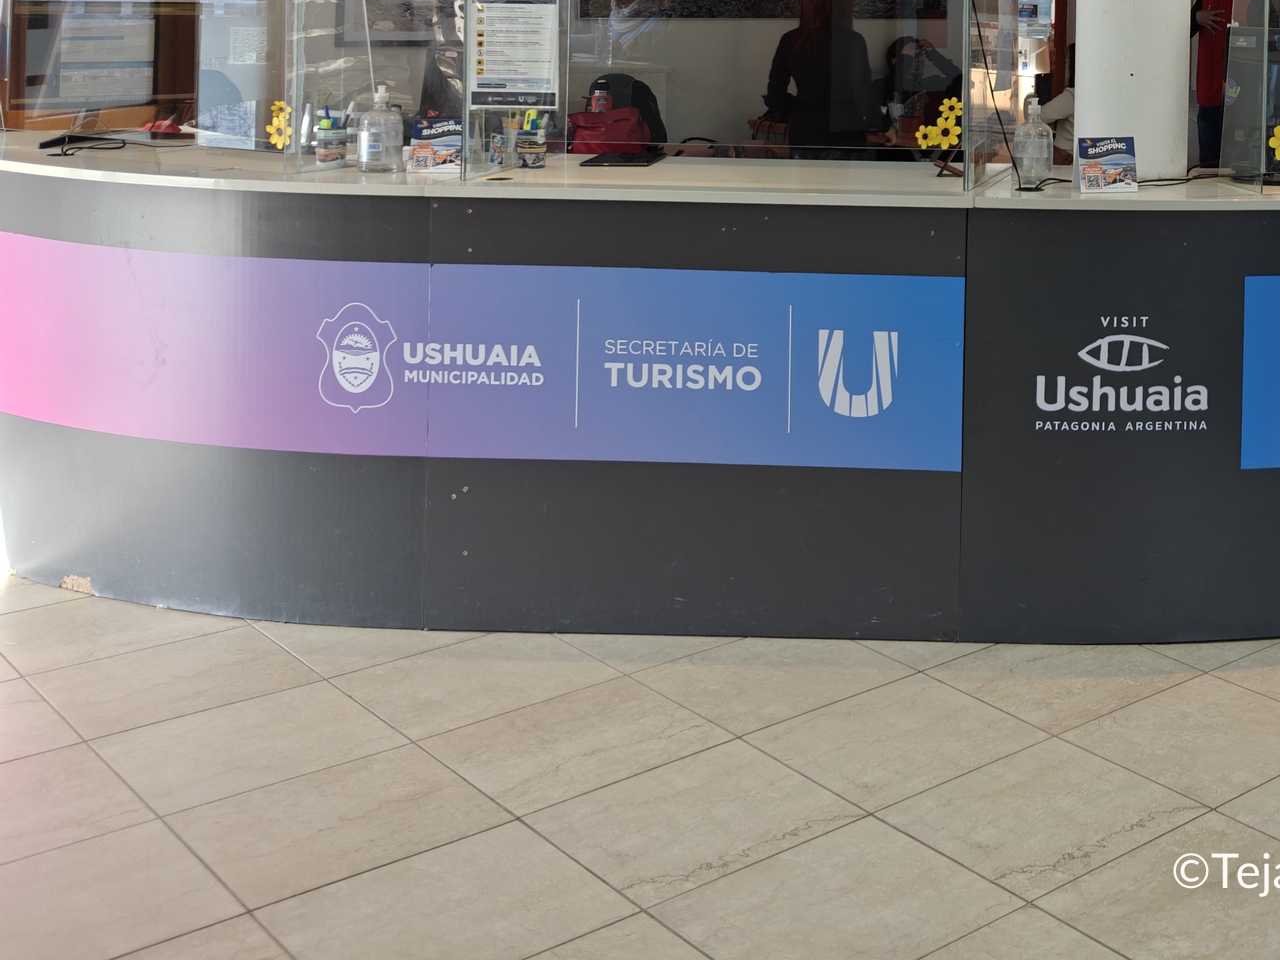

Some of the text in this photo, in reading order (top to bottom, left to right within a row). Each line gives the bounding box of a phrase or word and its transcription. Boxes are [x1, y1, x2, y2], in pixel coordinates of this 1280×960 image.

[1088, 142, 1126, 154] SHOPPING
[1100, 316, 1149, 328] VISIT
[402, 342, 542, 368] USHUAIA
[604, 337, 758, 358] SECRETARÍA DE
[404, 369, 544, 387] MUNICIPALIDAD
[604, 362, 762, 392] TURISMO
[1036, 375, 1208, 412] Ushuaia
[1036, 420, 1207, 431] PATAGONIA ARGENTINA
